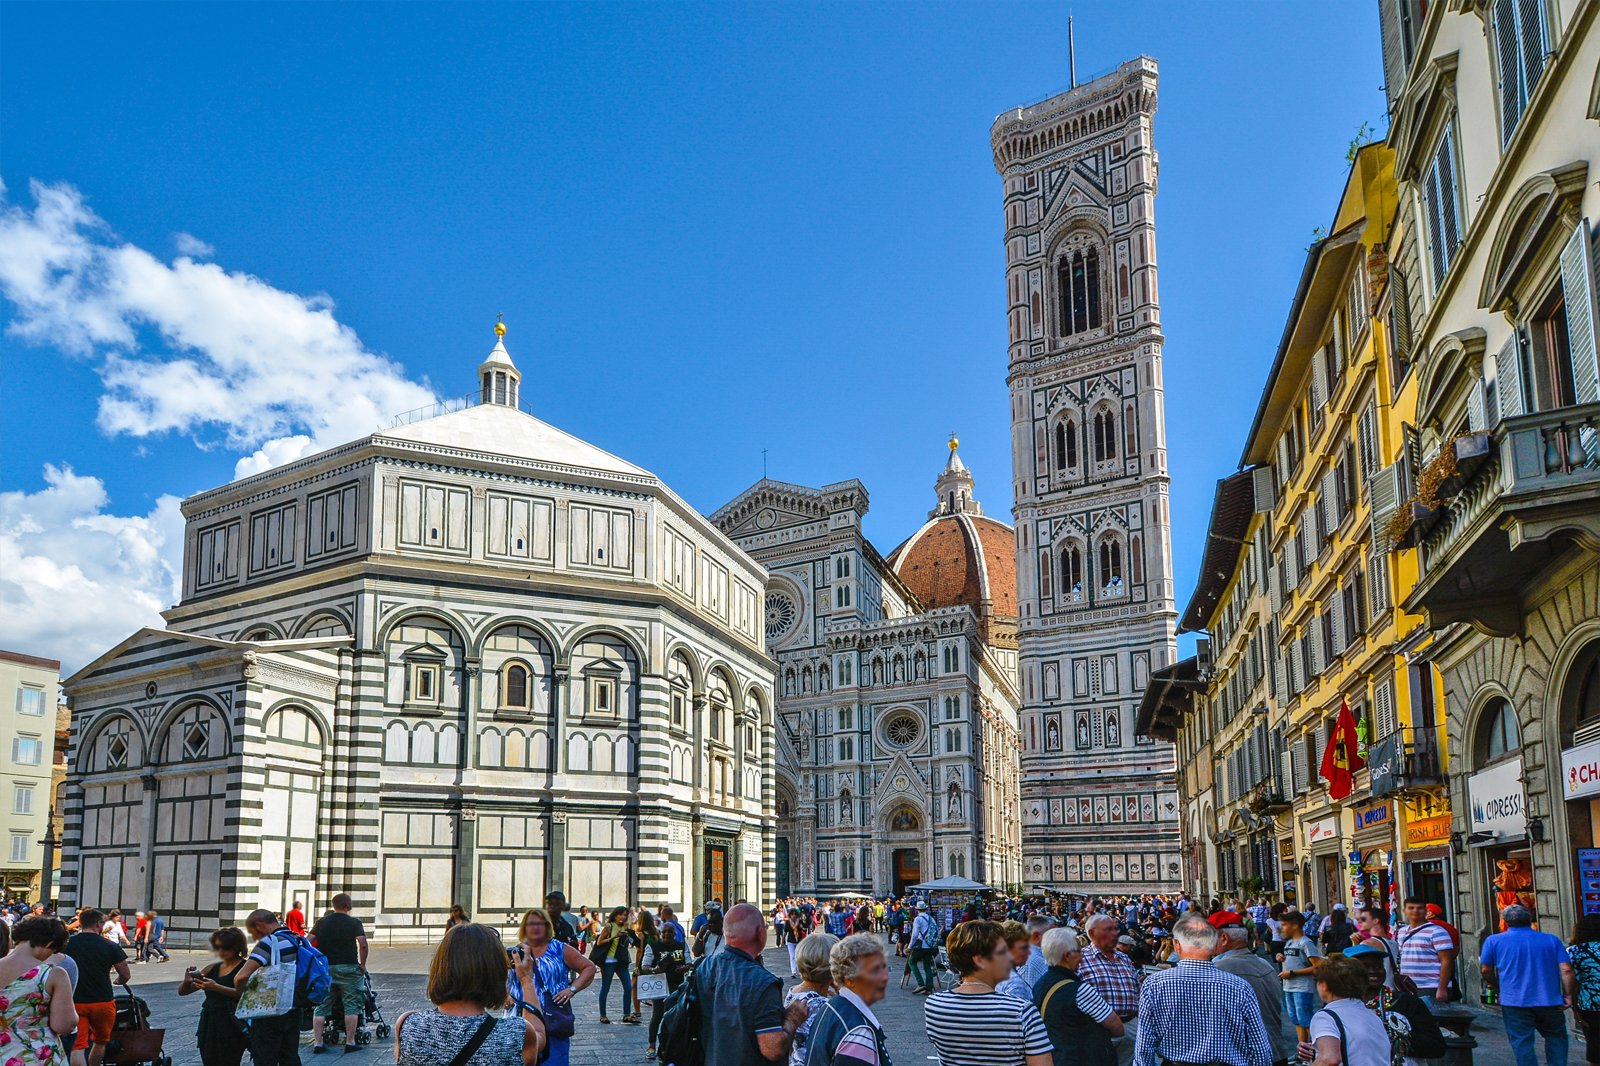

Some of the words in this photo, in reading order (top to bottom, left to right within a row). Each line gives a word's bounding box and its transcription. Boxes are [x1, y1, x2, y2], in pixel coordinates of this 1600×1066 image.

[1579, 762, 1600, 784] CH
[1486, 793, 1522, 820] CIPRESSI
[1408, 826, 1429, 840] IRISH
[641, 981, 663, 992] OVS
